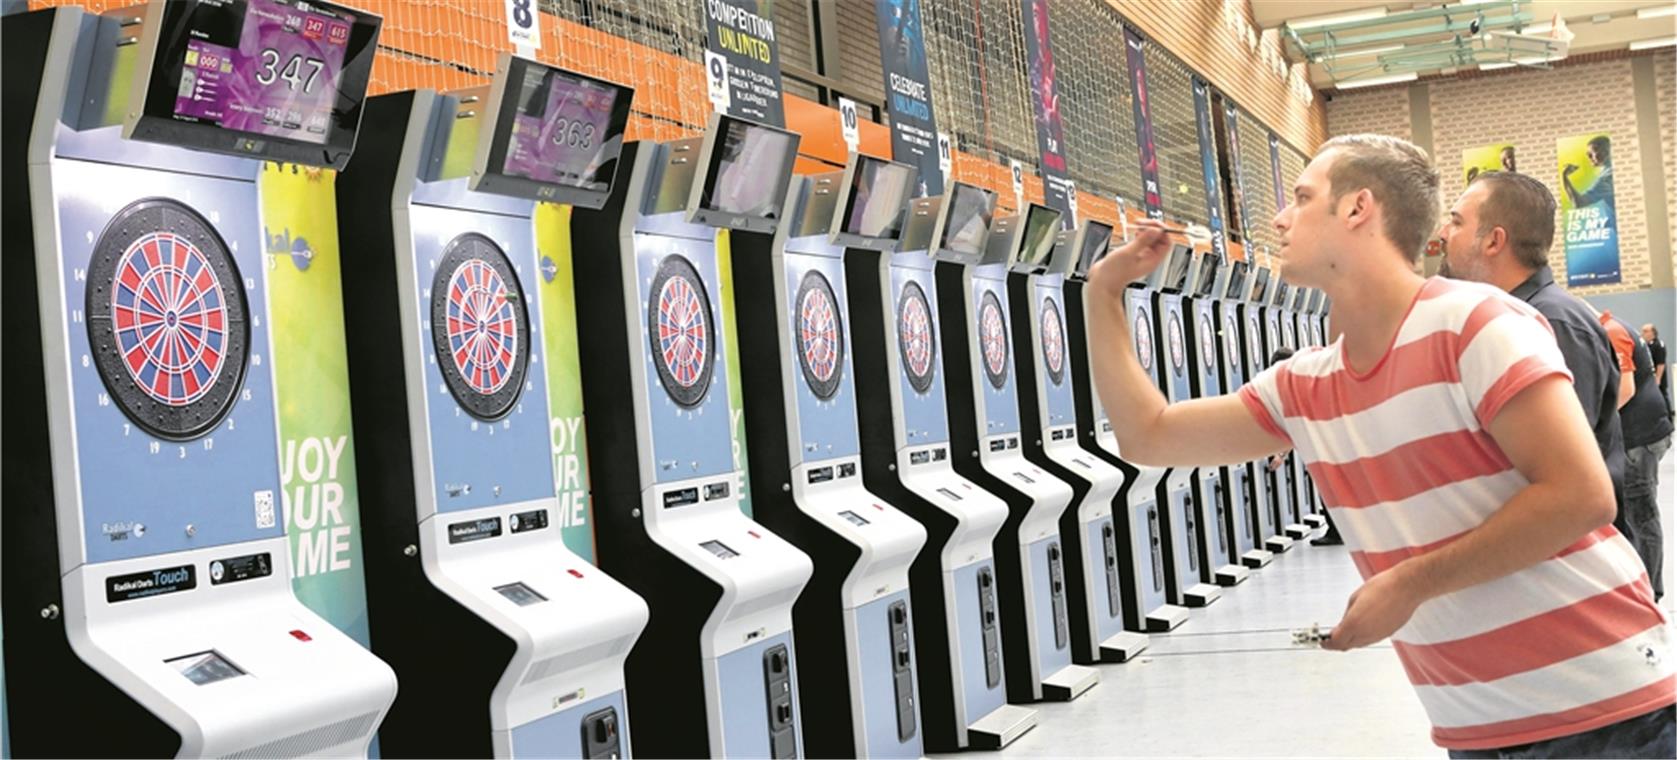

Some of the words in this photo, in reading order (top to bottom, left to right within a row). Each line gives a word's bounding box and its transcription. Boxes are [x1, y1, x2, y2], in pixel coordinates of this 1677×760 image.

[513, 0, 533, 29] 8
[708, 0, 775, 42] COMPETITION
[306, 19, 323, 33] 347
[331, 26, 347, 40] 615
[717, 25, 771, 64] UNLIMITED
[256, 49, 325, 94] 347
[710, 57, 725, 89] 9
[890, 72, 928, 102] CELEBRATE
[842, 105, 857, 130] 10
[552, 118, 596, 151] 363
[939, 139, 950, 161] 11
[1567, 206, 1601, 223] THIS
[1567, 220, 1582, 231] IS
[1585, 216, 1609, 231] MY
[1566, 227, 1611, 243] GAME
[82, 354, 90, 368] 8
[98, 393, 110, 407] 16
[123, 423, 131, 436] 7
[179, 446, 186, 459] 3
[152, 567, 189, 587] Touch
